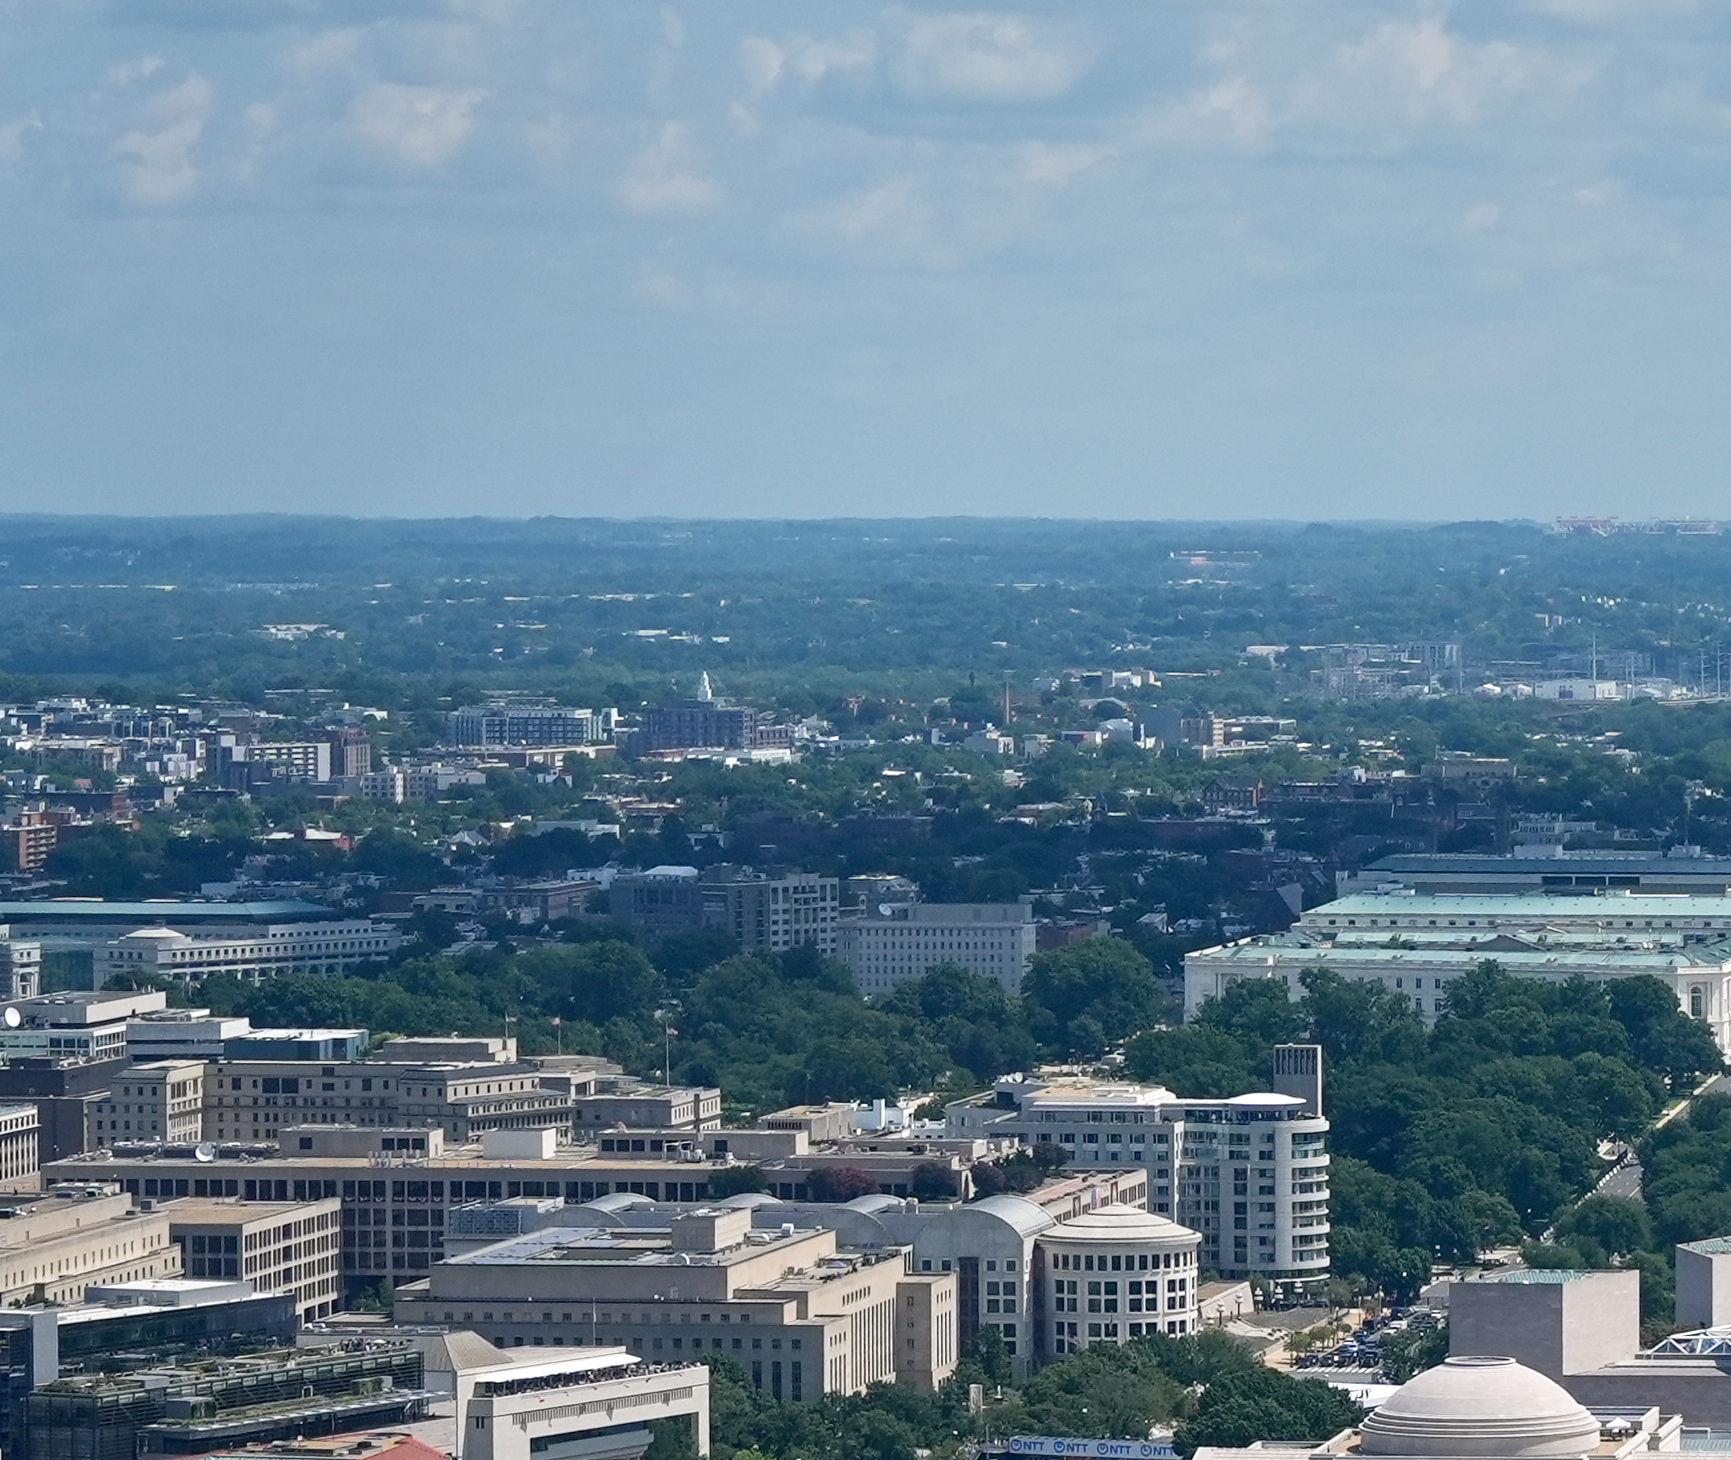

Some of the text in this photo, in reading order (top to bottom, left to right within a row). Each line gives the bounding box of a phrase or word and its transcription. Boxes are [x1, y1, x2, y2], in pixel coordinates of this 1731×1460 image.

[1023, 1441, 1044, 1450] NTT
[1064, 1443, 1088, 1453] NTT
[1107, 1445, 1131, 1455] NTT
